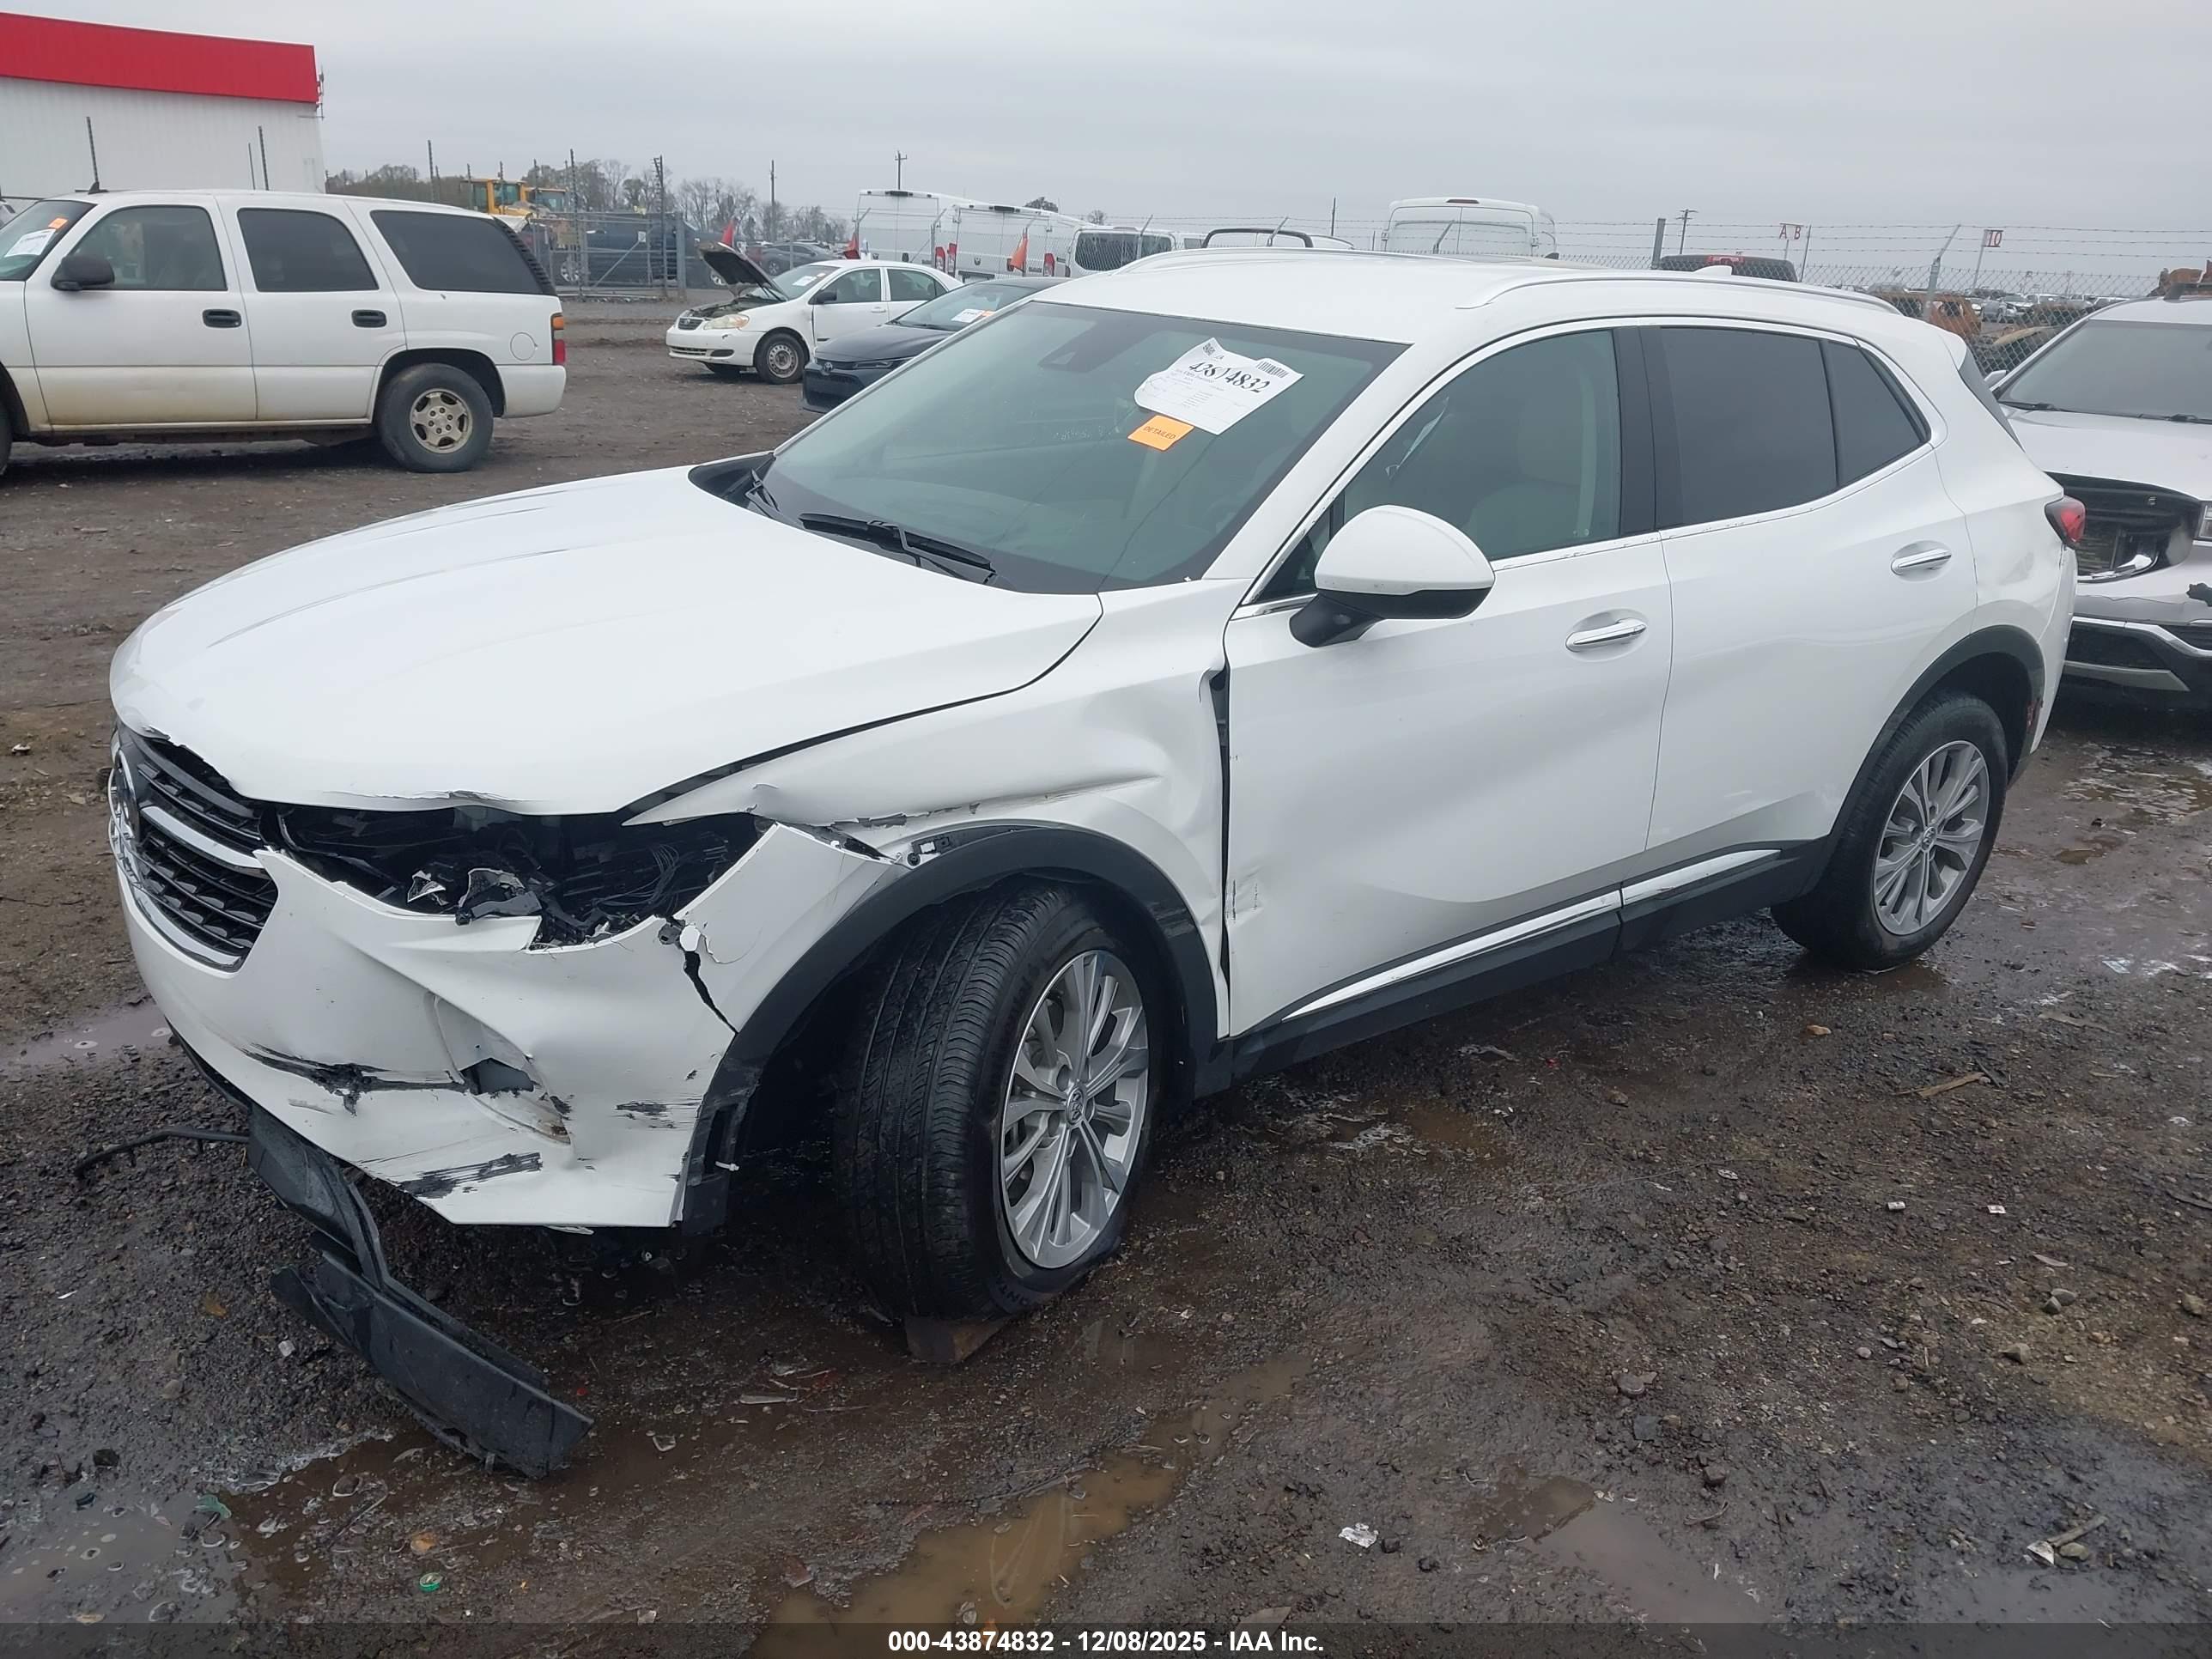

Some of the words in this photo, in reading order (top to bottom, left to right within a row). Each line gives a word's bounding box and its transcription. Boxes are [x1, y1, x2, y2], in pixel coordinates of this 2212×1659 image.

[1779, 223, 1787, 240] A
[1794, 226, 1802, 240] B
[1988, 231, 2002, 246] 10
[1143, 426, 1176, 440] DETAILED
